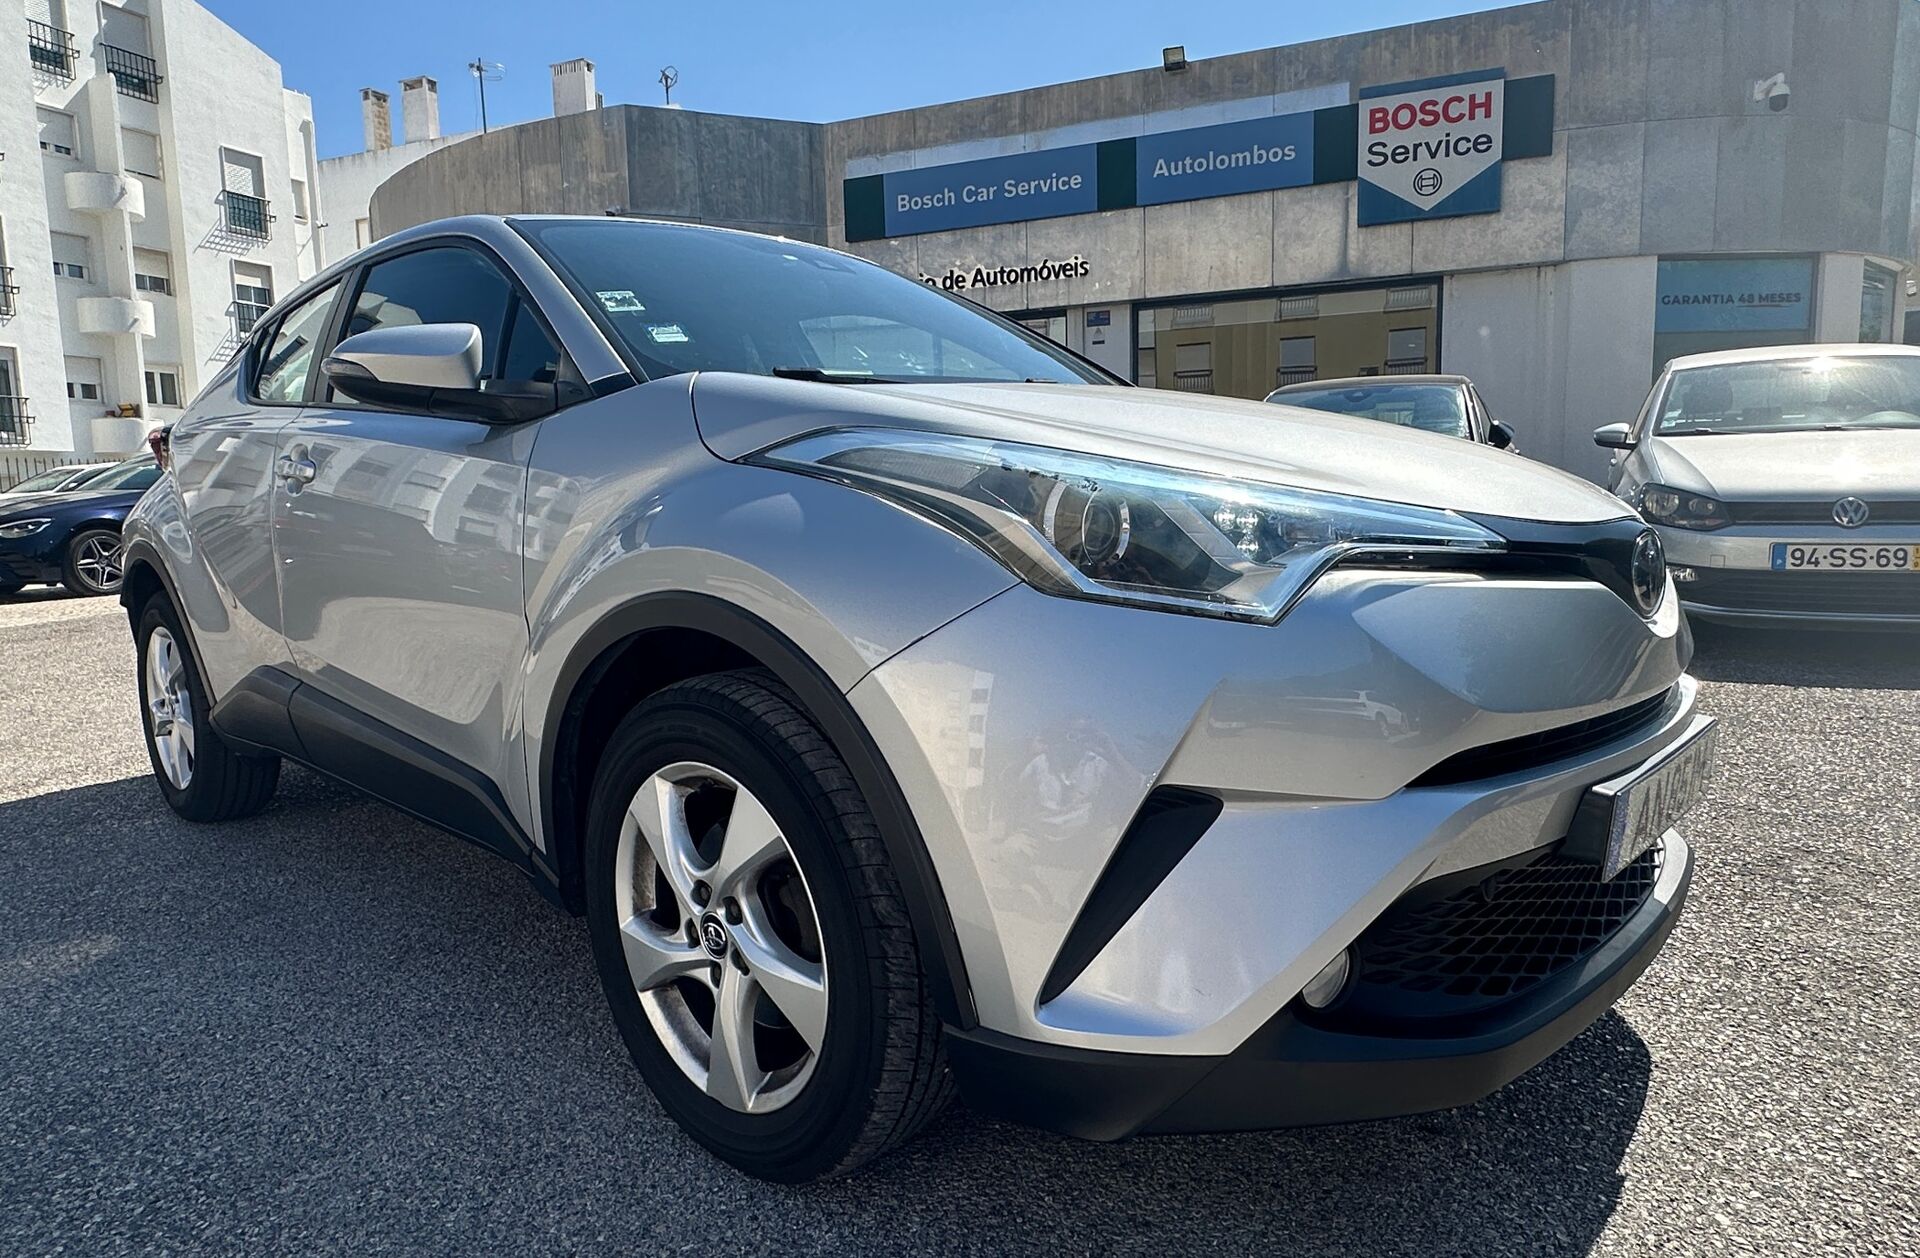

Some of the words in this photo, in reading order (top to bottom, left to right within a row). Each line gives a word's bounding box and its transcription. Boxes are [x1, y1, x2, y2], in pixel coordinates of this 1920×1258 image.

[1368, 91, 1493, 135] BOSCH
[1152, 144, 1297, 178] Autolombos
[1366, 132, 1493, 167] Service
[897, 187, 956, 212] Bosch
[962, 185, 998, 203] Car
[1003, 172, 1082, 198] Service
[942, 270, 966, 290] de
[971, 256, 1090, 288] Automóveis
[1661, 294, 1735, 306] GARANTIA
[1738, 293, 1755, 304] 48
[1758, 292, 1802, 304] MESES
